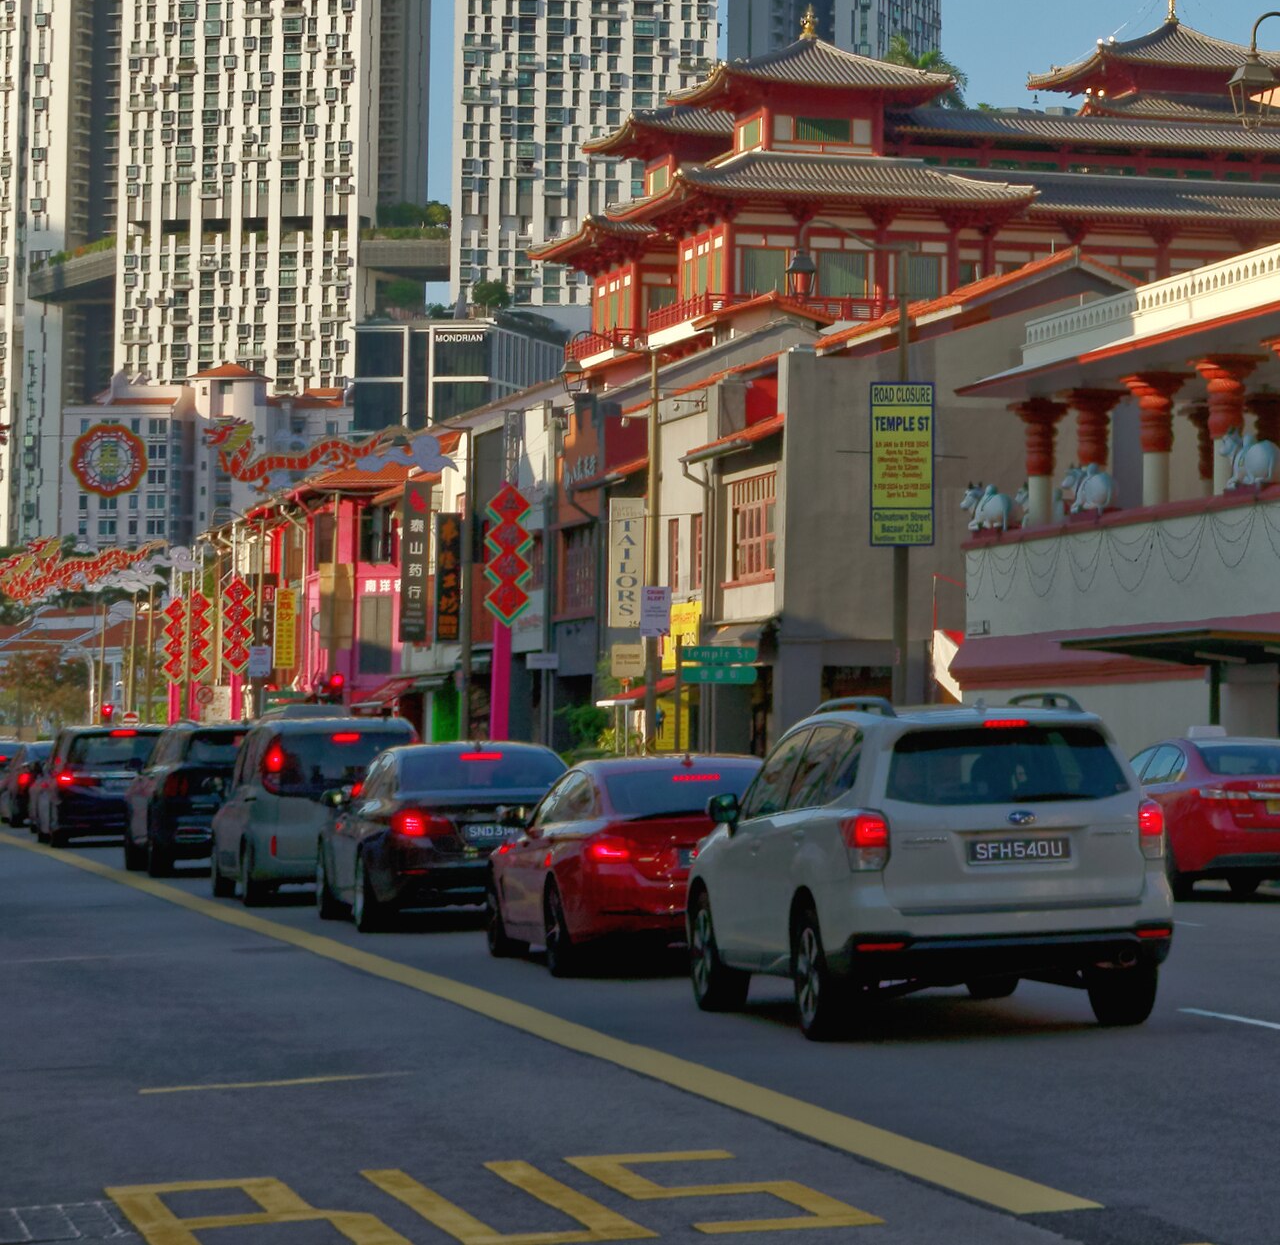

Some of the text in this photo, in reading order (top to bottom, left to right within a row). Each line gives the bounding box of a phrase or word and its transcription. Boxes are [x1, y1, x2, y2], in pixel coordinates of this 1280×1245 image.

[435, 333, 484, 343] MONDRIAN
[873, 387, 931, 403] ROAD CLOSURE
[874, 416, 930, 432] TEMPLE ST
[408, 519, 424, 599] 泰山药行
[616, 519, 638, 617] TAILORS
[687, 648, 749, 660] Temple St
